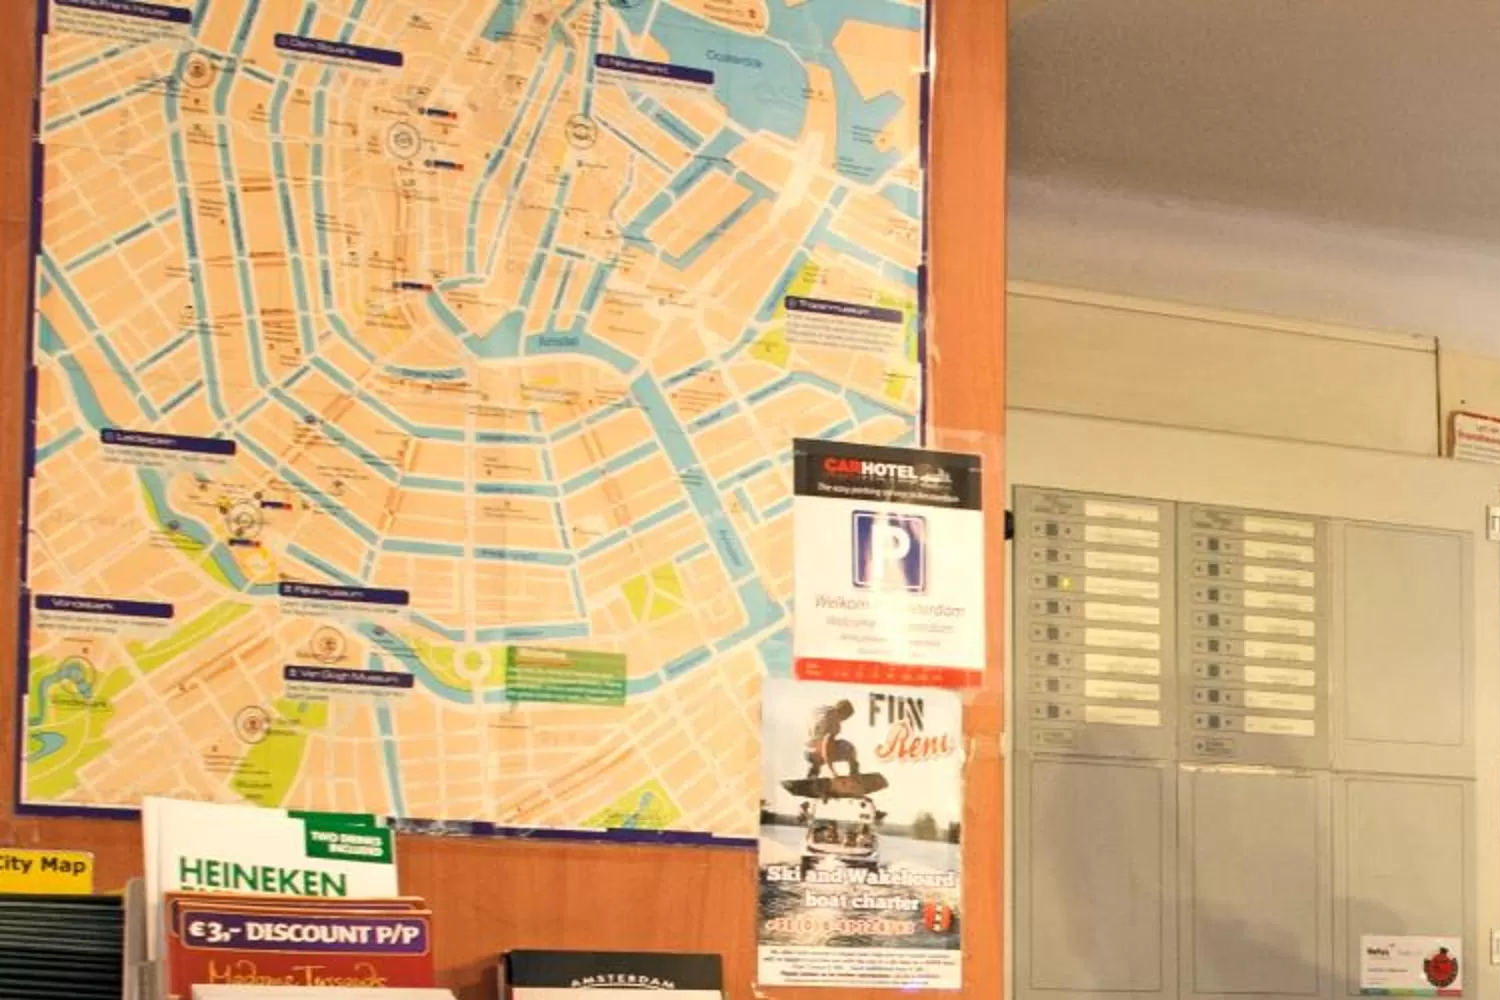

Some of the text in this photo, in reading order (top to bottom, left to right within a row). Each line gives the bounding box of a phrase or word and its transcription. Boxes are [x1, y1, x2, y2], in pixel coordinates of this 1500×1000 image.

[41, 855, 87, 877] Map
[179, 857, 347, 897] HEINEKEN
[767, 866, 799, 881] Ski
[806, 868, 842, 883] and
[188, 921, 420, 947] €3,- DISCOUNT P/P
[571, 974, 676, 989] AMSTERDAM
